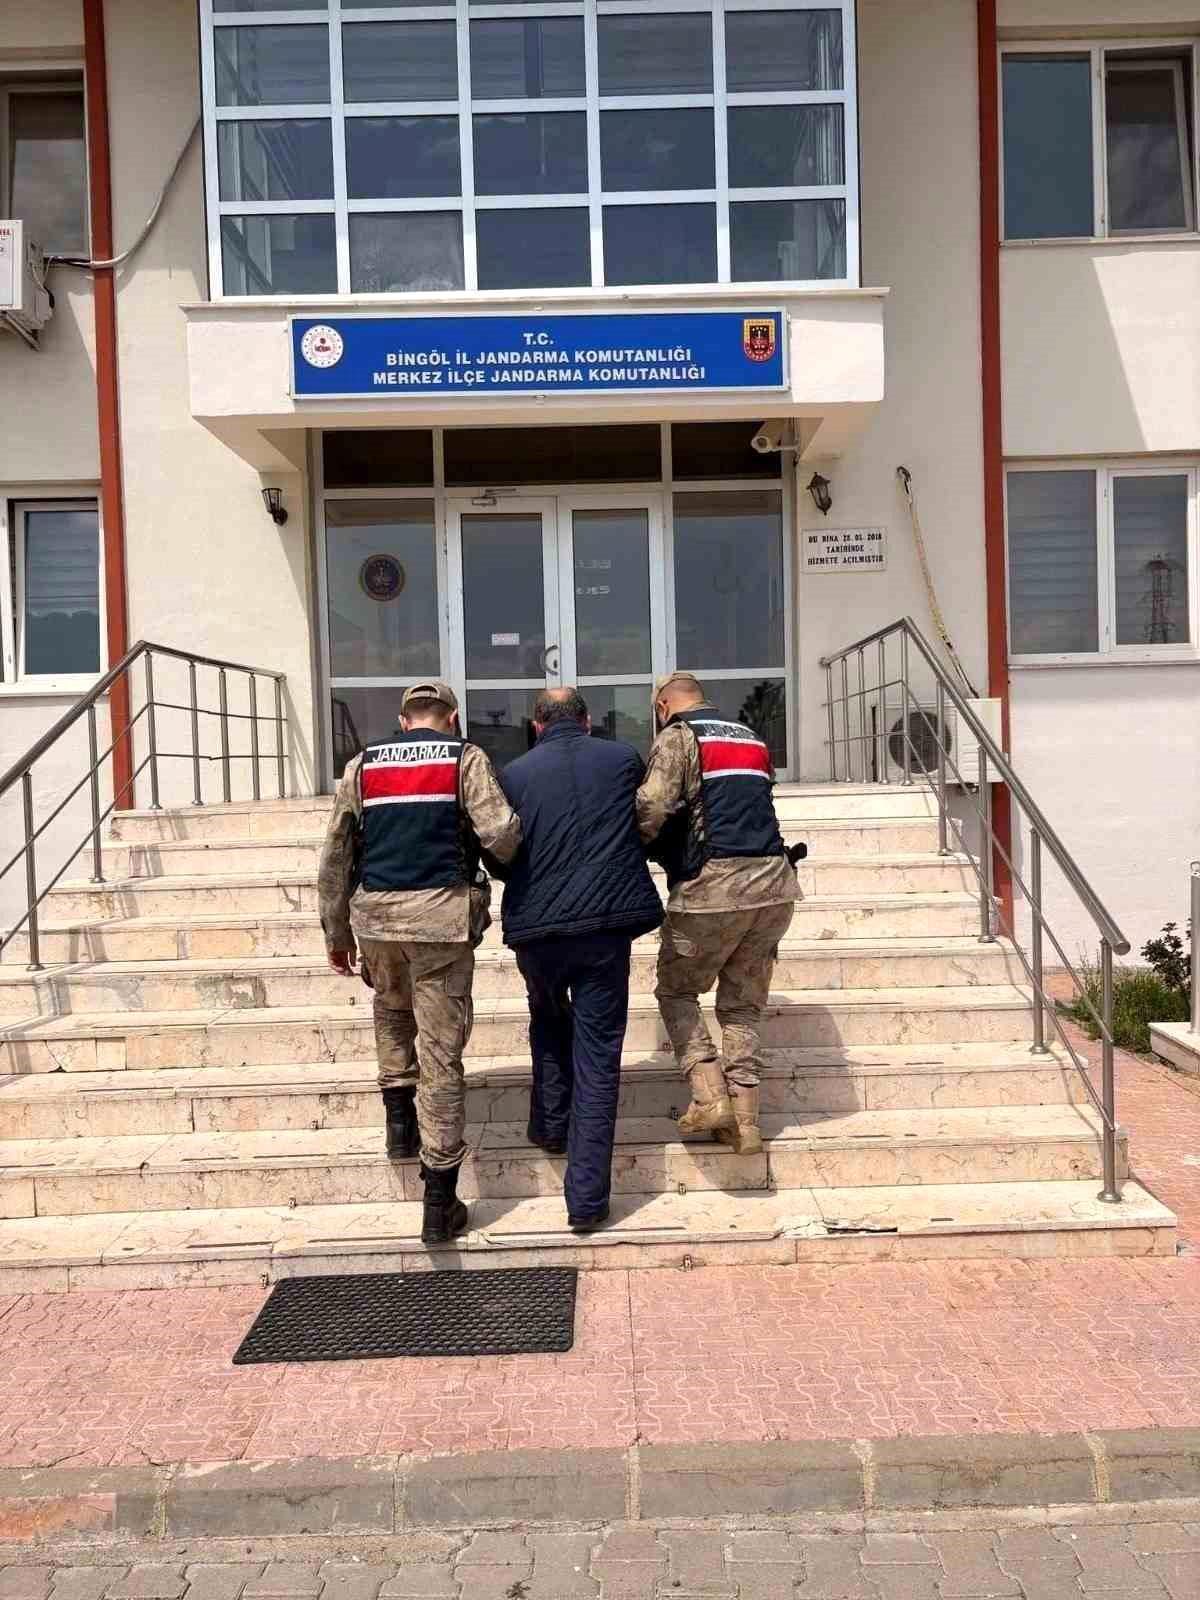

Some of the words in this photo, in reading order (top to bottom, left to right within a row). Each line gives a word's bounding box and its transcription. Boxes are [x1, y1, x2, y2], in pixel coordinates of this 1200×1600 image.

[523, 331, 554, 346] T.C.
[386, 349, 450, 366] BİNGÖL
[456, 349, 471, 365] İL
[476, 351, 569, 365] JANDARMA
[574, 345, 691, 363] KOMUTANLIĞI
[373, 371, 442, 385] MERKEZ
[448, 368, 485, 386] İLÇE
[491, 369, 583, 383] JANDARMA
[588, 364, 705, 381] KOMUTANLIĞI
[373, 745, 449, 762] JANDARMA
